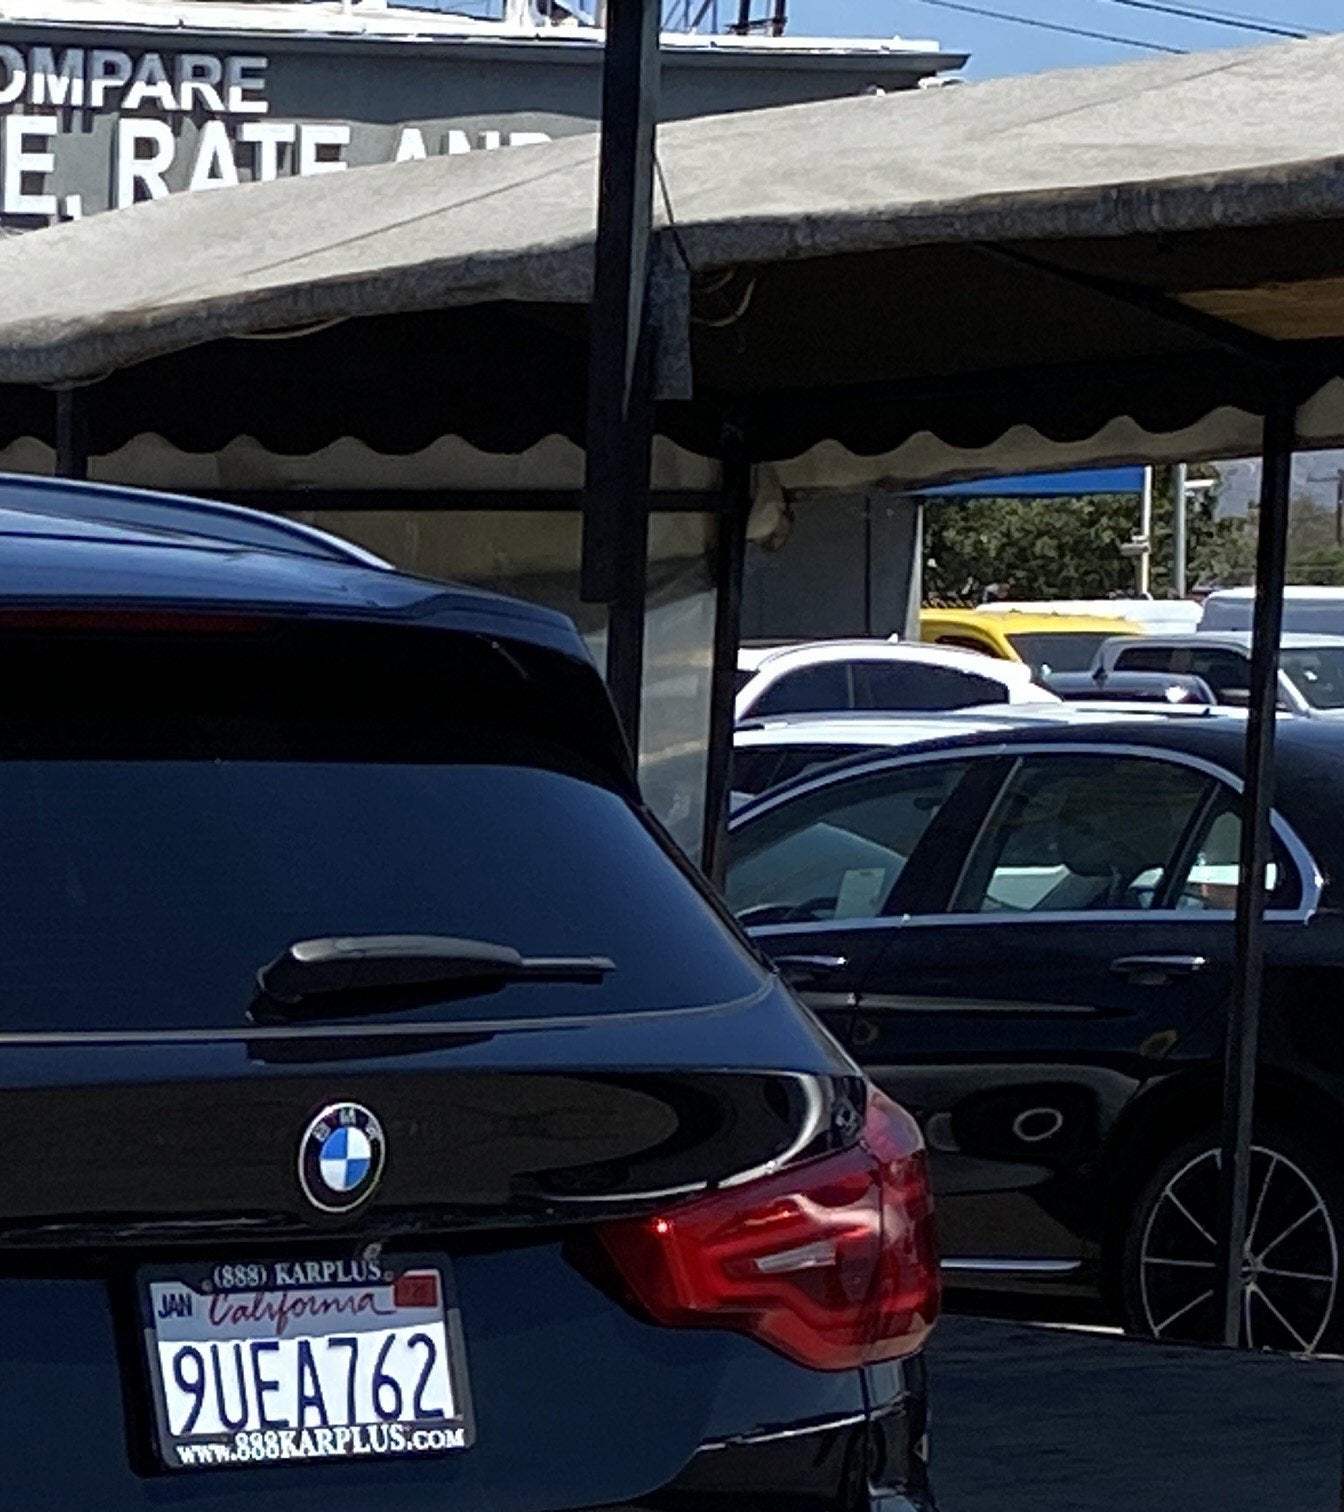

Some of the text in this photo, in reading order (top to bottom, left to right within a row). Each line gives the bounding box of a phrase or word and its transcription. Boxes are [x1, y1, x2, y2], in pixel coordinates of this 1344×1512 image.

[213, 1260, 382, 1289] (888) KARPLUS
[158, 1292, 192, 1318] JAN
[207, 1289, 396, 1335] California
[172, 1332, 445, 1435] 9UEA762
